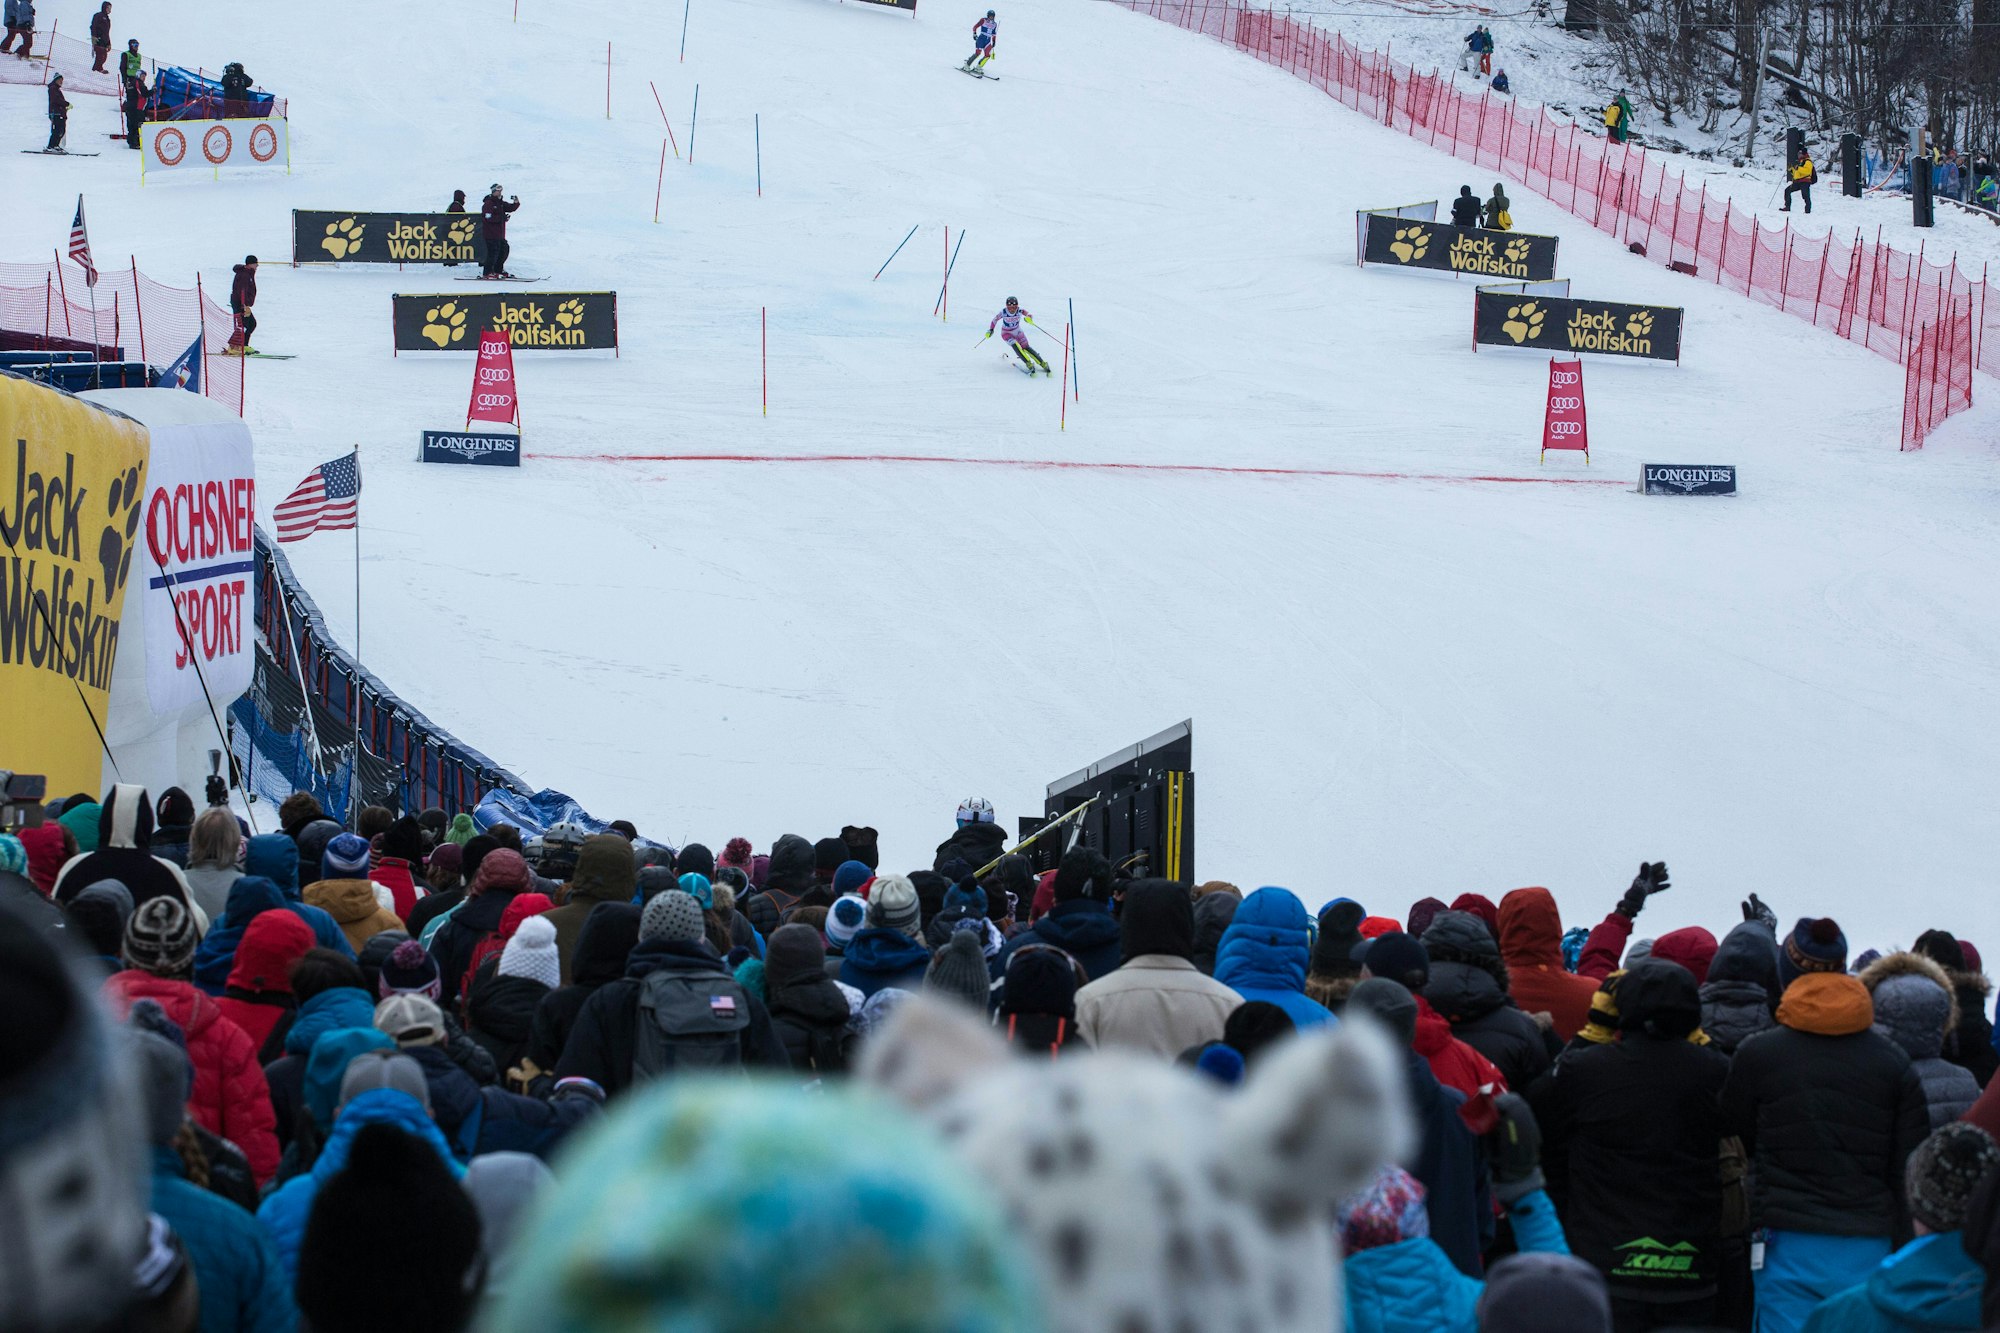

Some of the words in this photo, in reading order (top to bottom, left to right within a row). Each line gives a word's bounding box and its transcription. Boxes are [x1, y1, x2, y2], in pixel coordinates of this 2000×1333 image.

[387, 221, 438, 240] Jack
[387, 240, 475, 260] Wolfskin
[1450, 233, 1496, 256] Jack
[1449, 250, 1528, 278] Wolfskin
[493, 302, 545, 323] Jack
[1567, 308, 1616, 331] Jack
[1567, 327, 1651, 354] Wolfskin
[427, 436, 515, 451] LONGINES
[1647, 468, 1731, 482] LONGINES
[0, 439, 87, 562] Jack
[0, 556, 119, 693] Wolfskin
[174, 580, 245, 670] SPORT
